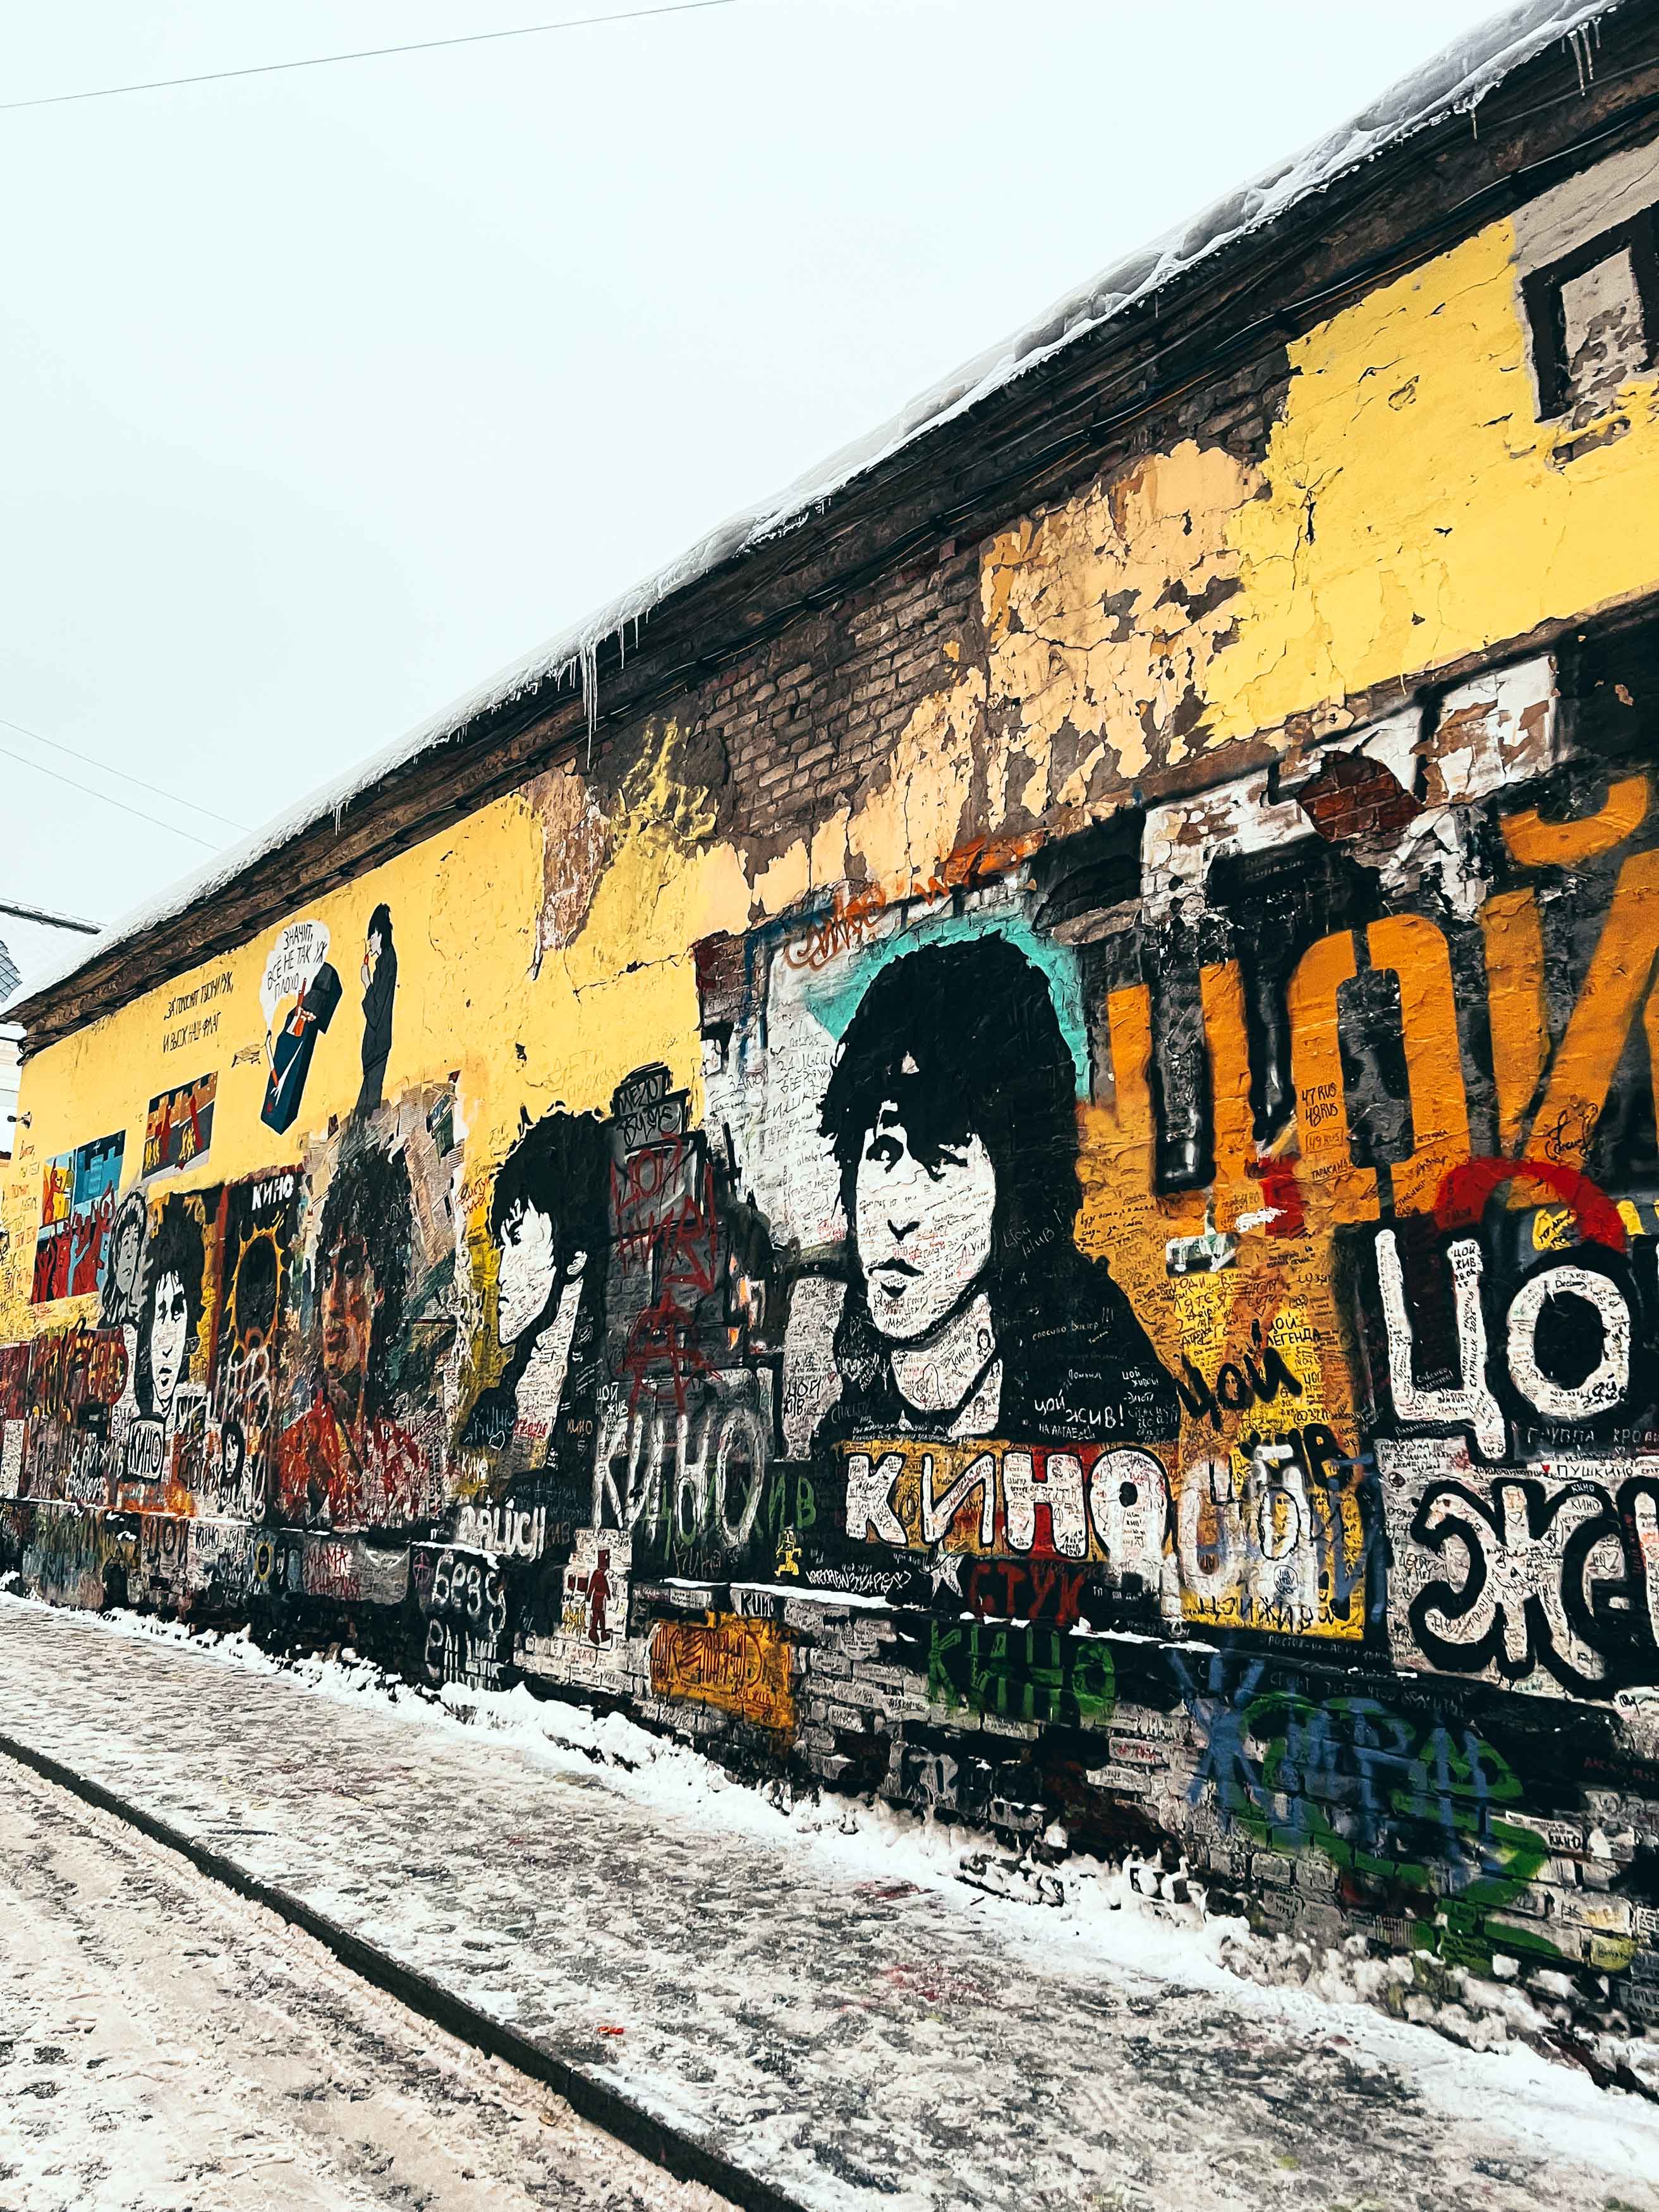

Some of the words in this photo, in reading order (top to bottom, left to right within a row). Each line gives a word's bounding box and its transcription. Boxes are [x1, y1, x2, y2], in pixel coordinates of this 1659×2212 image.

[284, 949, 295, 973] НЕ
[297, 944, 312, 964] ТАК
[274, 973, 300, 1002] ПЛОХО
[163, 1034, 169, 1053] И
[1302, 1087, 1316, 1106] 47
[1317, 1081, 1337, 1100] RUS
[252, 1174, 295, 1212] КИНО
[1454, 1242, 1477, 1258] ЦОЙ
[1454, 1258, 1478, 1272] ЖИВ
[1266, 1328, 1322, 1347] ЛЕГЕНДА
[1374, 1229, 1659, 1461] ЦО
[951, 1346, 973, 1370] КИНО
[1122, 1366, 1141, 1380] ЦОЙ
[596, 1382, 619, 1401] ЦОЙ
[606, 1399, 629, 1417] ЖИВ
[1034, 1388, 1066, 1416] ЦОЙ
[1066, 1402, 1125, 1429] ЖИВ!
[566, 1420, 594, 1436] КИНО
[1557, 1464, 1634, 1478] ПУШКИНО
[844, 1447, 1174, 1559] КИНО
[1570, 1498, 1600, 1512] КИНО
